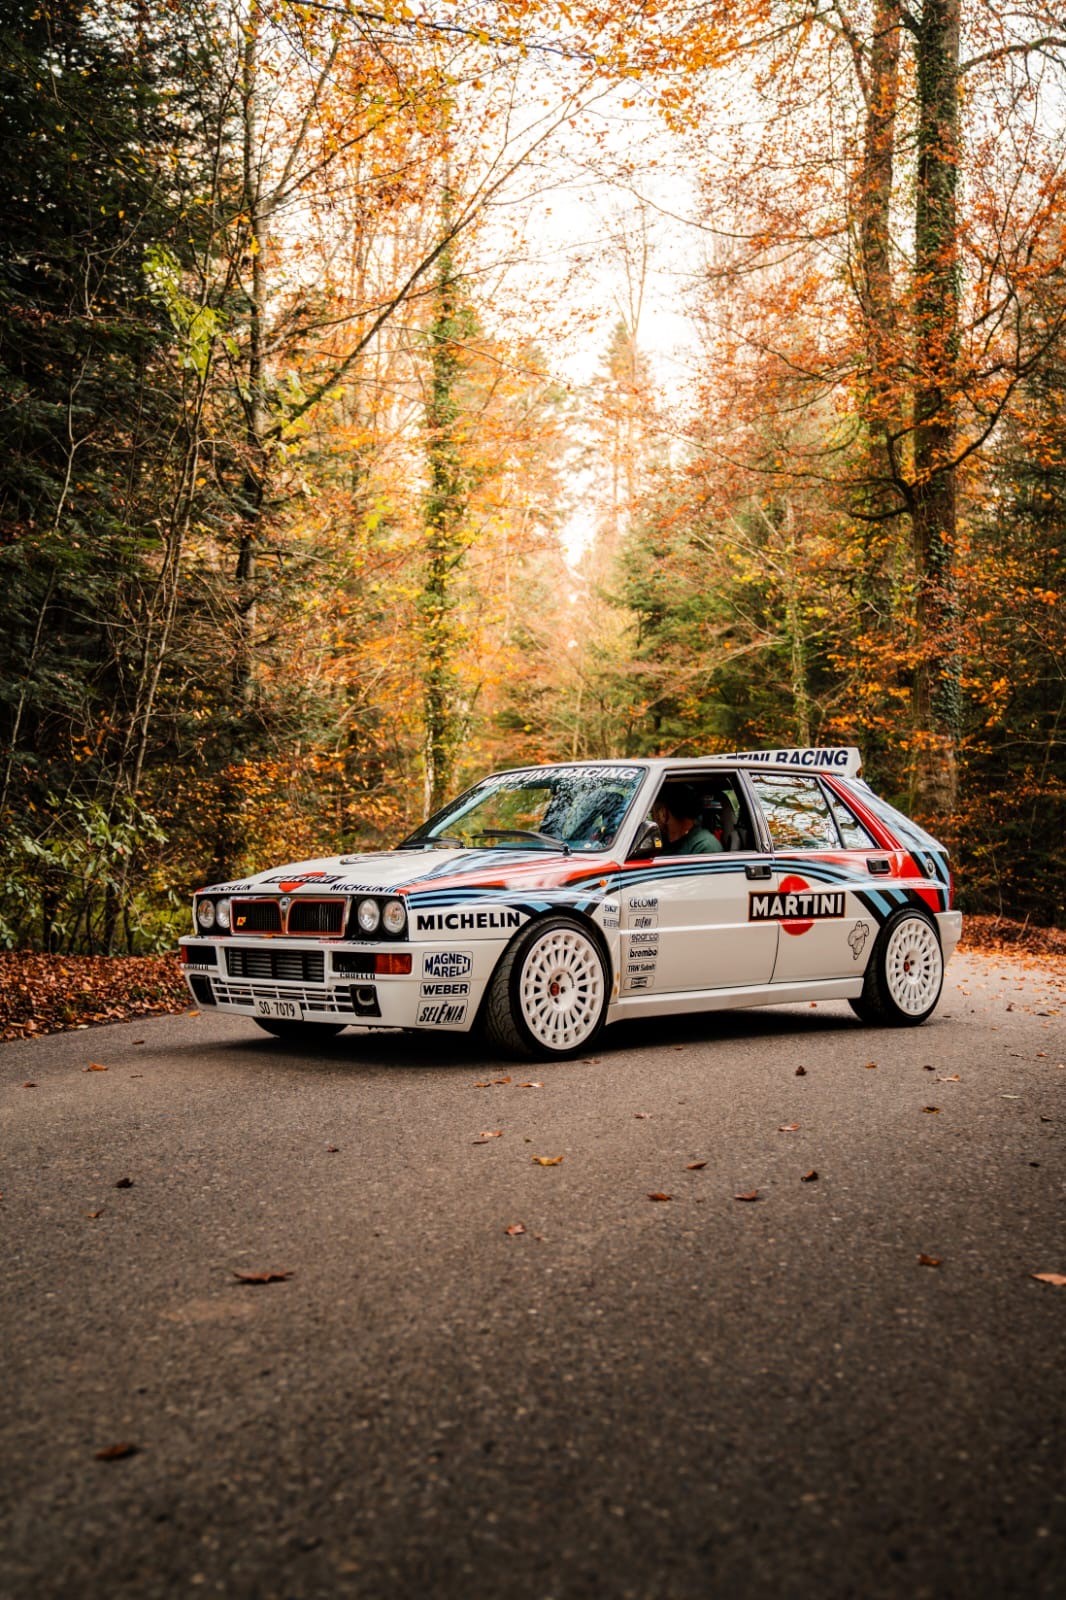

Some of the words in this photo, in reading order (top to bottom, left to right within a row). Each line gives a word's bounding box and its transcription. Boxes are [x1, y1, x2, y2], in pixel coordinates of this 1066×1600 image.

[775, 750, 848, 766] RACING
[557, 767, 638, 780] RACING
[330, 883, 386, 893] MICHELIN
[752, 894, 842, 917] MARTINI
[417, 912, 521, 930] MICHELIN
[629, 948, 657, 958] brembo
[423, 983, 468, 995] WEBER
